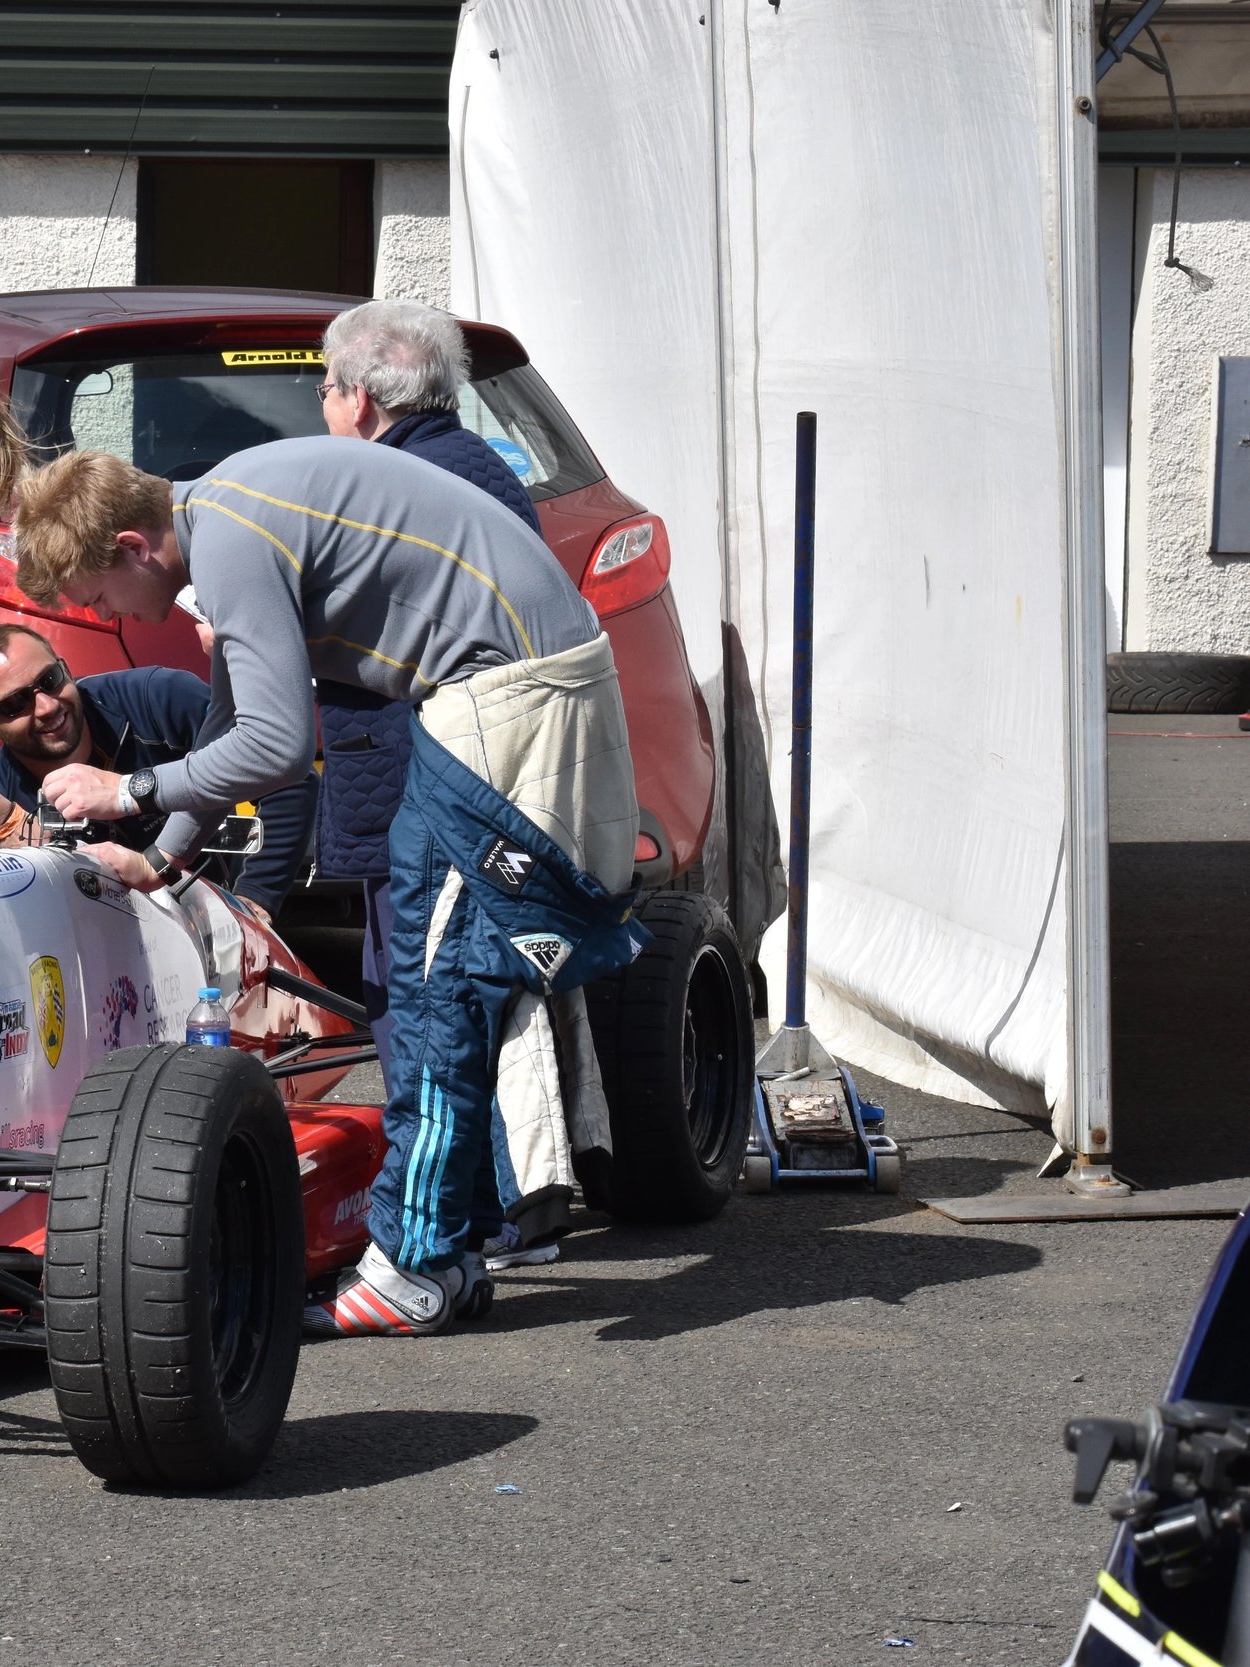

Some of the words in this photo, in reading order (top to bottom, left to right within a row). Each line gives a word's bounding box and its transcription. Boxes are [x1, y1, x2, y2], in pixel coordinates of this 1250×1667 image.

[231, 352, 307, 362] Arnold
[483, 840, 505, 869] WALERO
[524, 940, 561, 952] adidas
